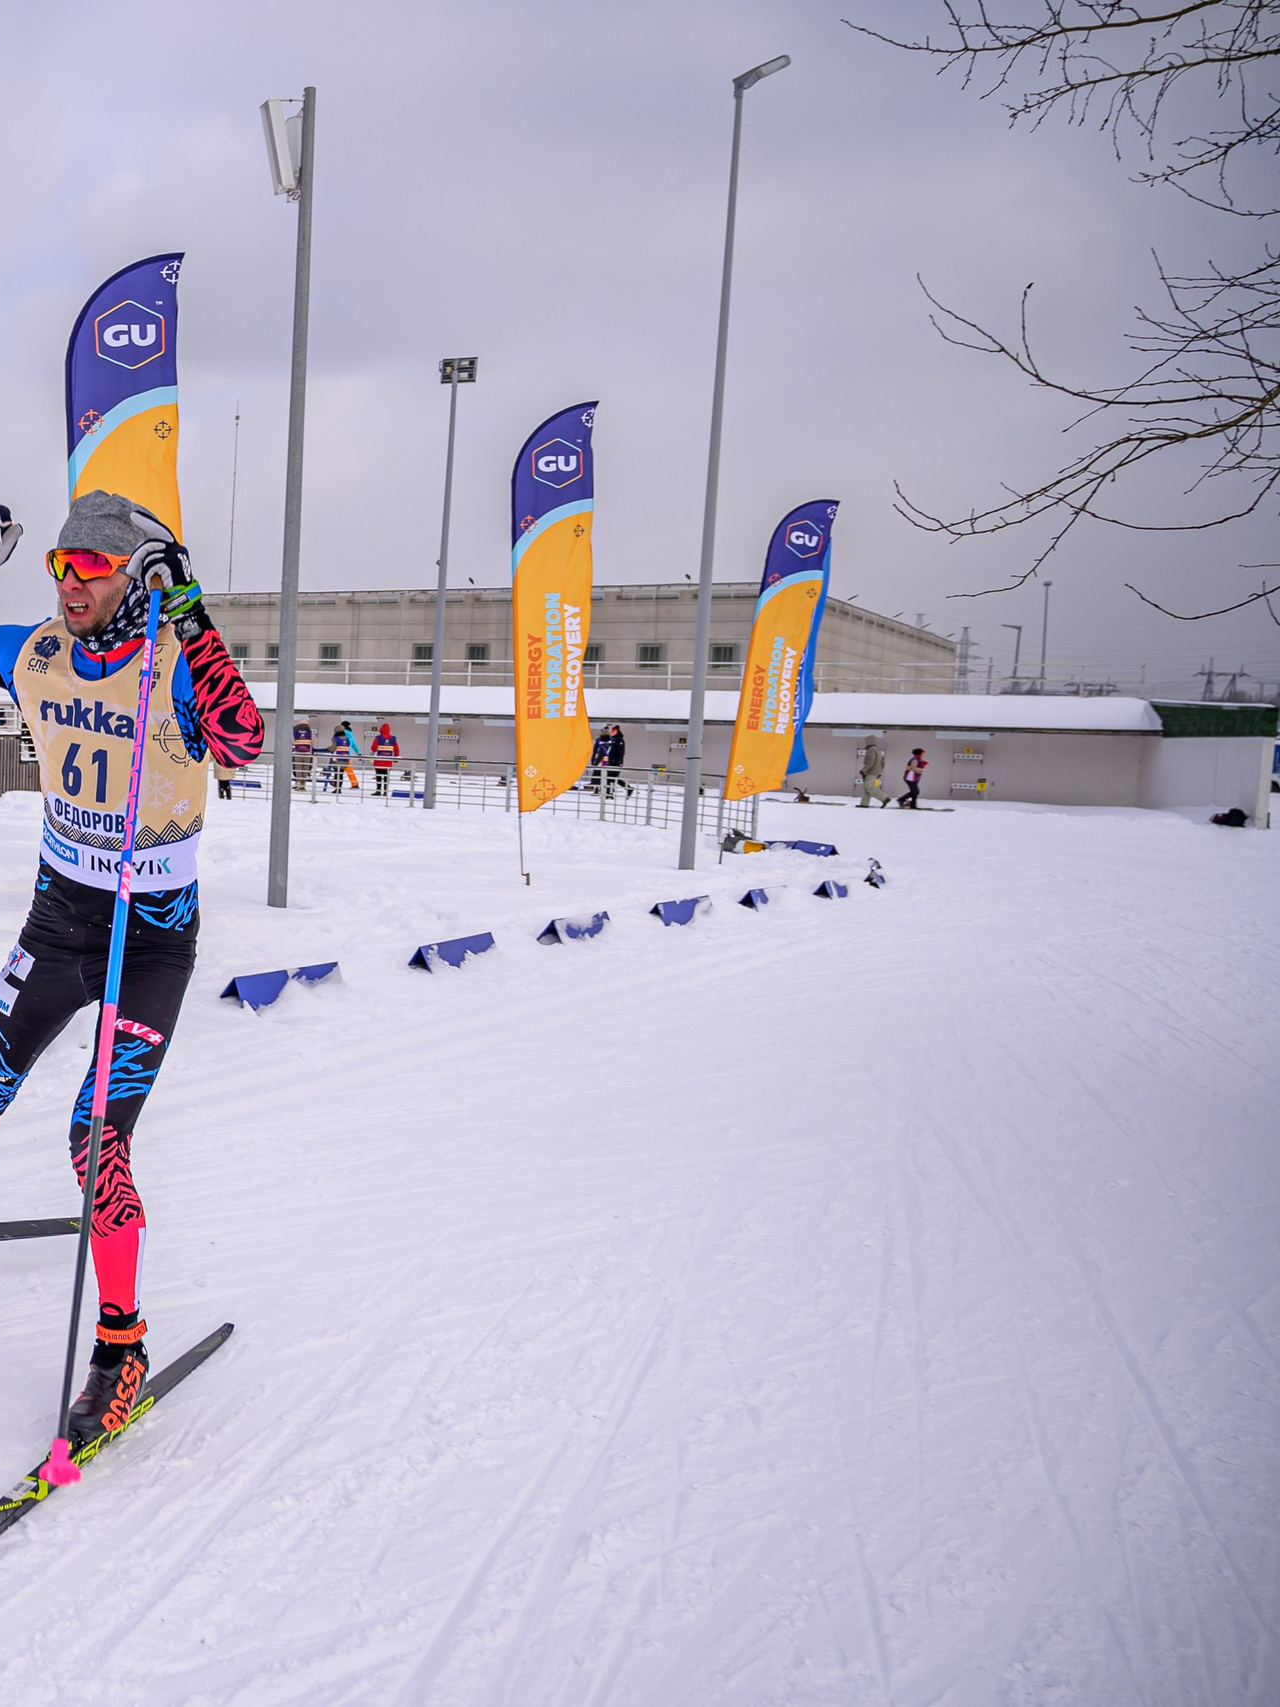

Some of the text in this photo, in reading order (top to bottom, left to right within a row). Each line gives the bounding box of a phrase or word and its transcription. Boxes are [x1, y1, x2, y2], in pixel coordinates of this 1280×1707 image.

[103, 324, 157, 348] GU
[537, 454, 578, 473] GU
[790, 531, 819, 548] GU
[527, 633, 543, 720] ENERGY
[544, 592, 561, 720] HYDRATION
[563, 603, 583, 718] RECOVERY
[761, 636, 785, 734] HYDRATION
[39, 697, 135, 740] rukka
[746, 664, 766, 732] ENERGY
[775, 646, 798, 735] RECOVERY
[61, 743, 108, 804] 61
[54, 797, 125, 834] ФЕДОРОВ
